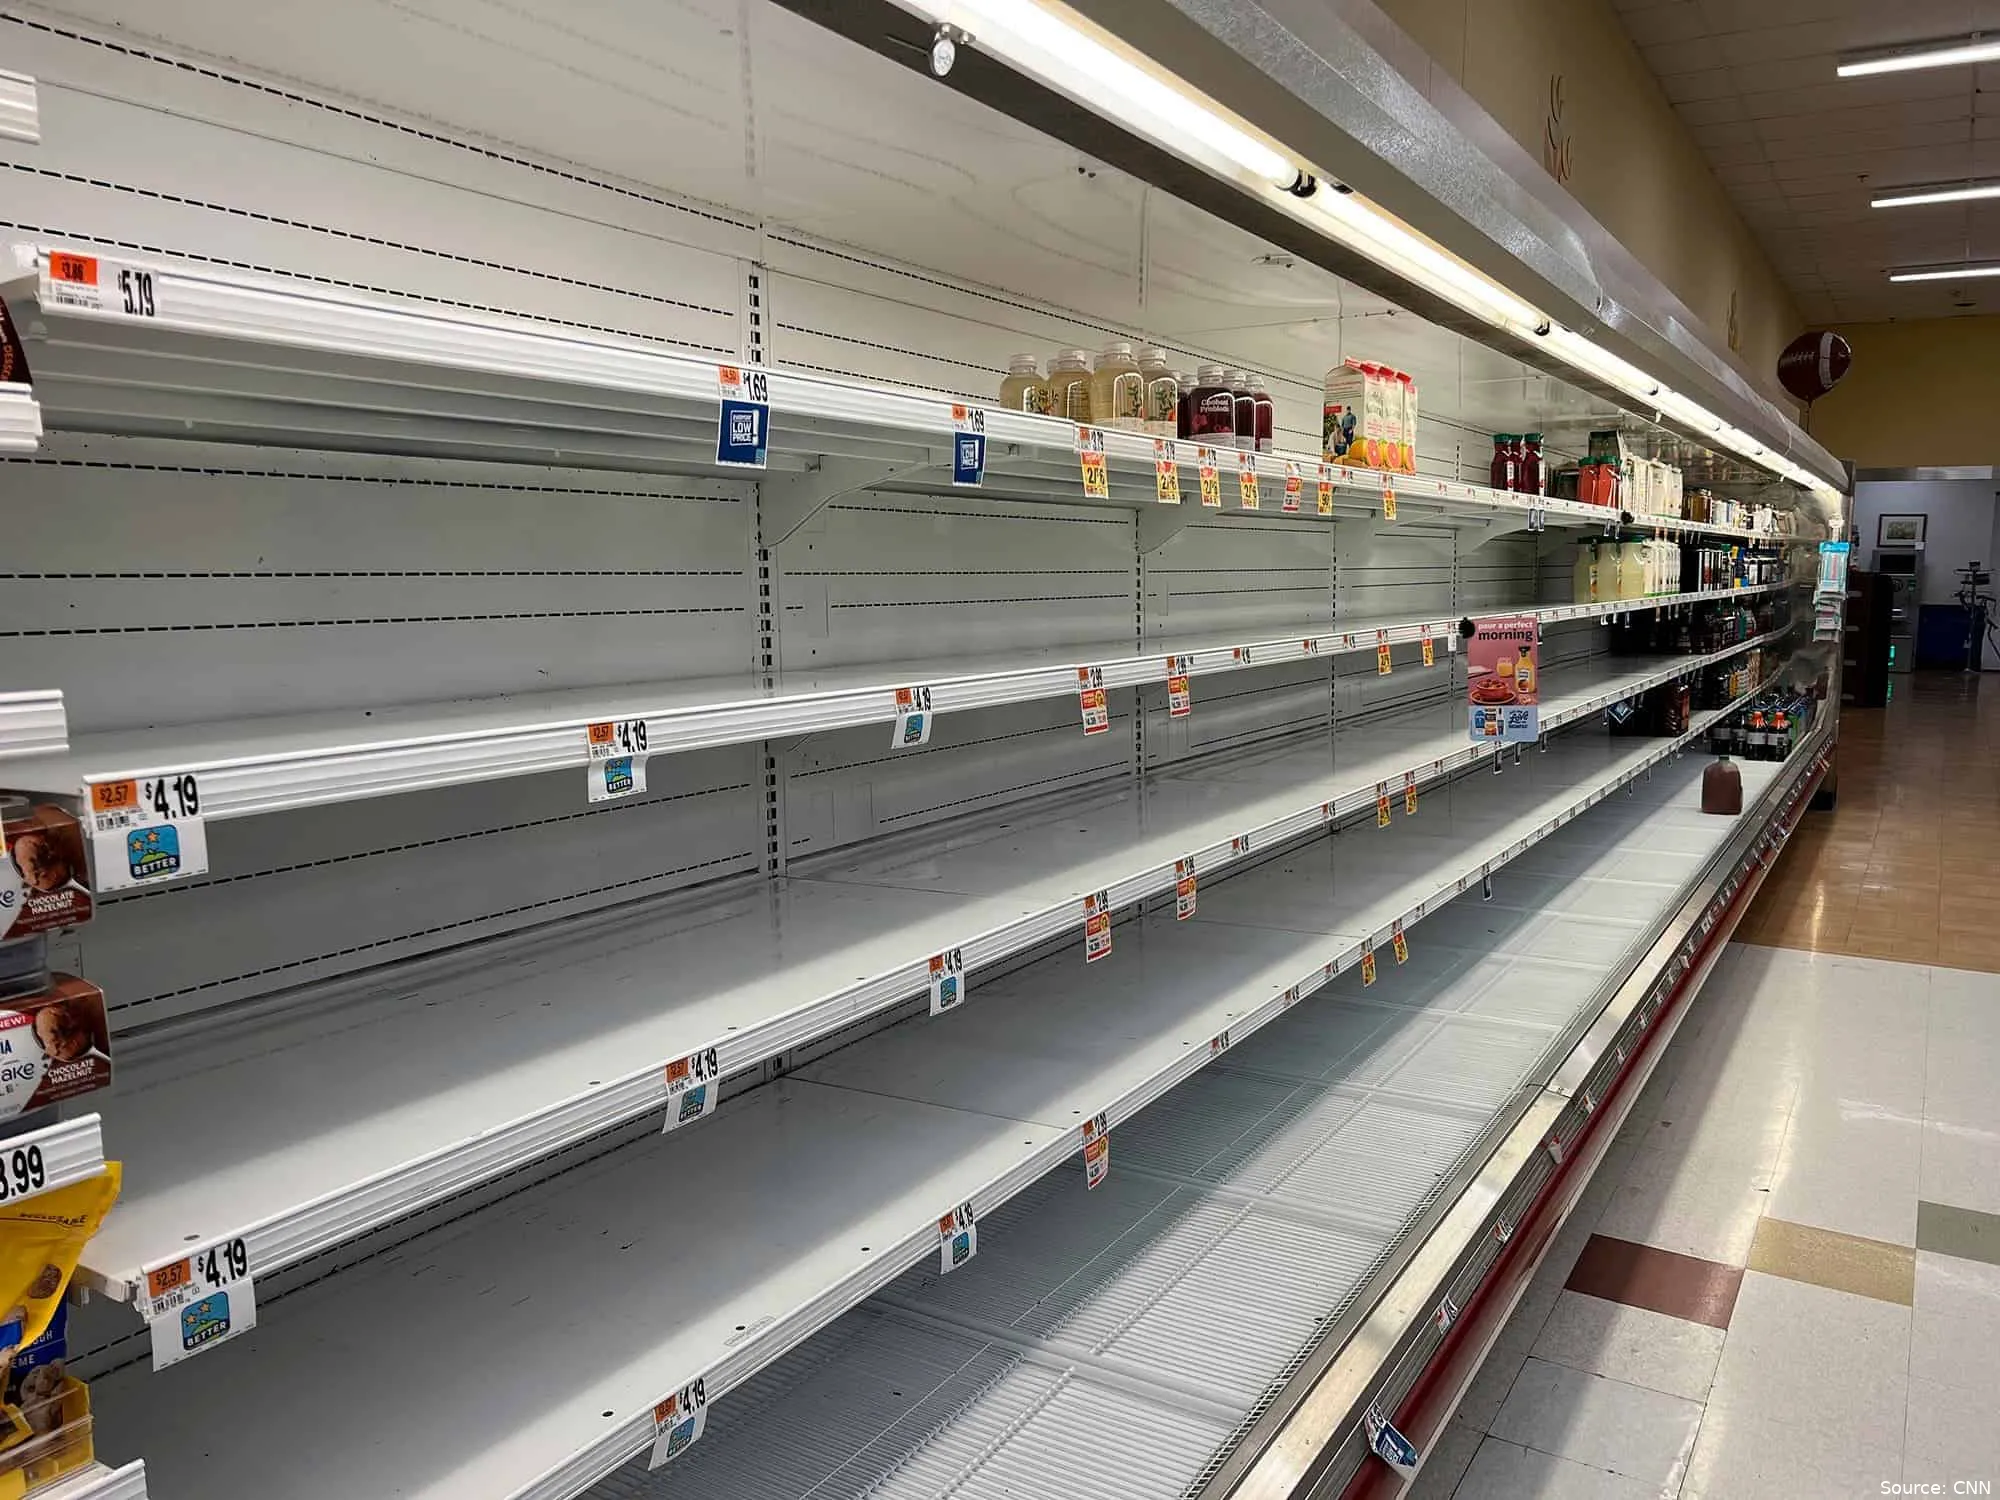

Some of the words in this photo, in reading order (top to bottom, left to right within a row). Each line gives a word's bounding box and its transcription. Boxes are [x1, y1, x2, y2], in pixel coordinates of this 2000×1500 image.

[732, 422, 752, 433] LOW
[1478, 629, 1533, 642] morning
[1504, 621, 1532, 630] perfect
[616, 720, 647, 752] $4.19
[99, 784, 129, 804] $2.57
[145, 775, 199, 820] $4.19
[134, 857, 178, 875] BETTER
[691, 1048, 718, 1082] $4.19
[198, 1238, 248, 1288] $4.19
[156, 1264, 182, 1288] $2.57
[187, 1321, 227, 1347] BETTER
[680, 1378, 706, 1415] $4.19
